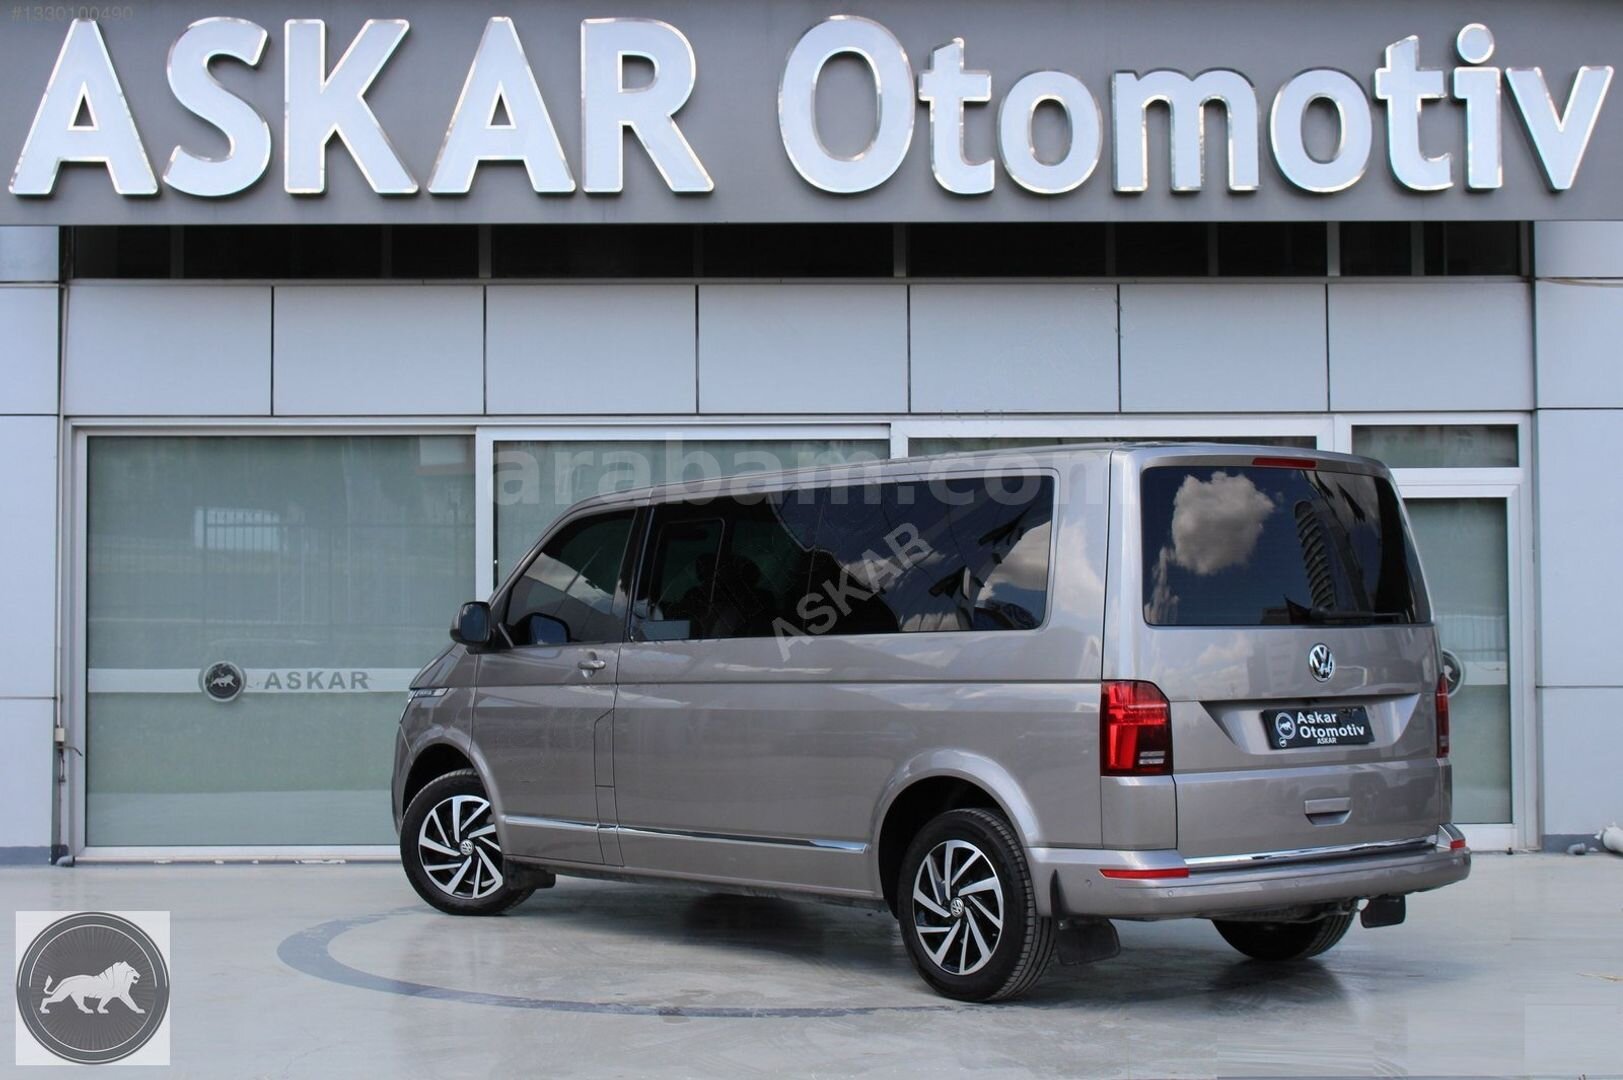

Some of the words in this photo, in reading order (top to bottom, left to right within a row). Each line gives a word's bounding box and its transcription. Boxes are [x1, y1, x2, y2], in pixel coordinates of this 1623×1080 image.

[9, 16, 715, 197] ASKAR
[777, 14, 1616, 195] Otomotiv
[264, 671, 369, 690] ASKAR
[1297, 711, 1337, 724] Askar
[1300, 723, 1365, 738] Otomotiv
[1316, 737, 1337, 745] ASKAR
